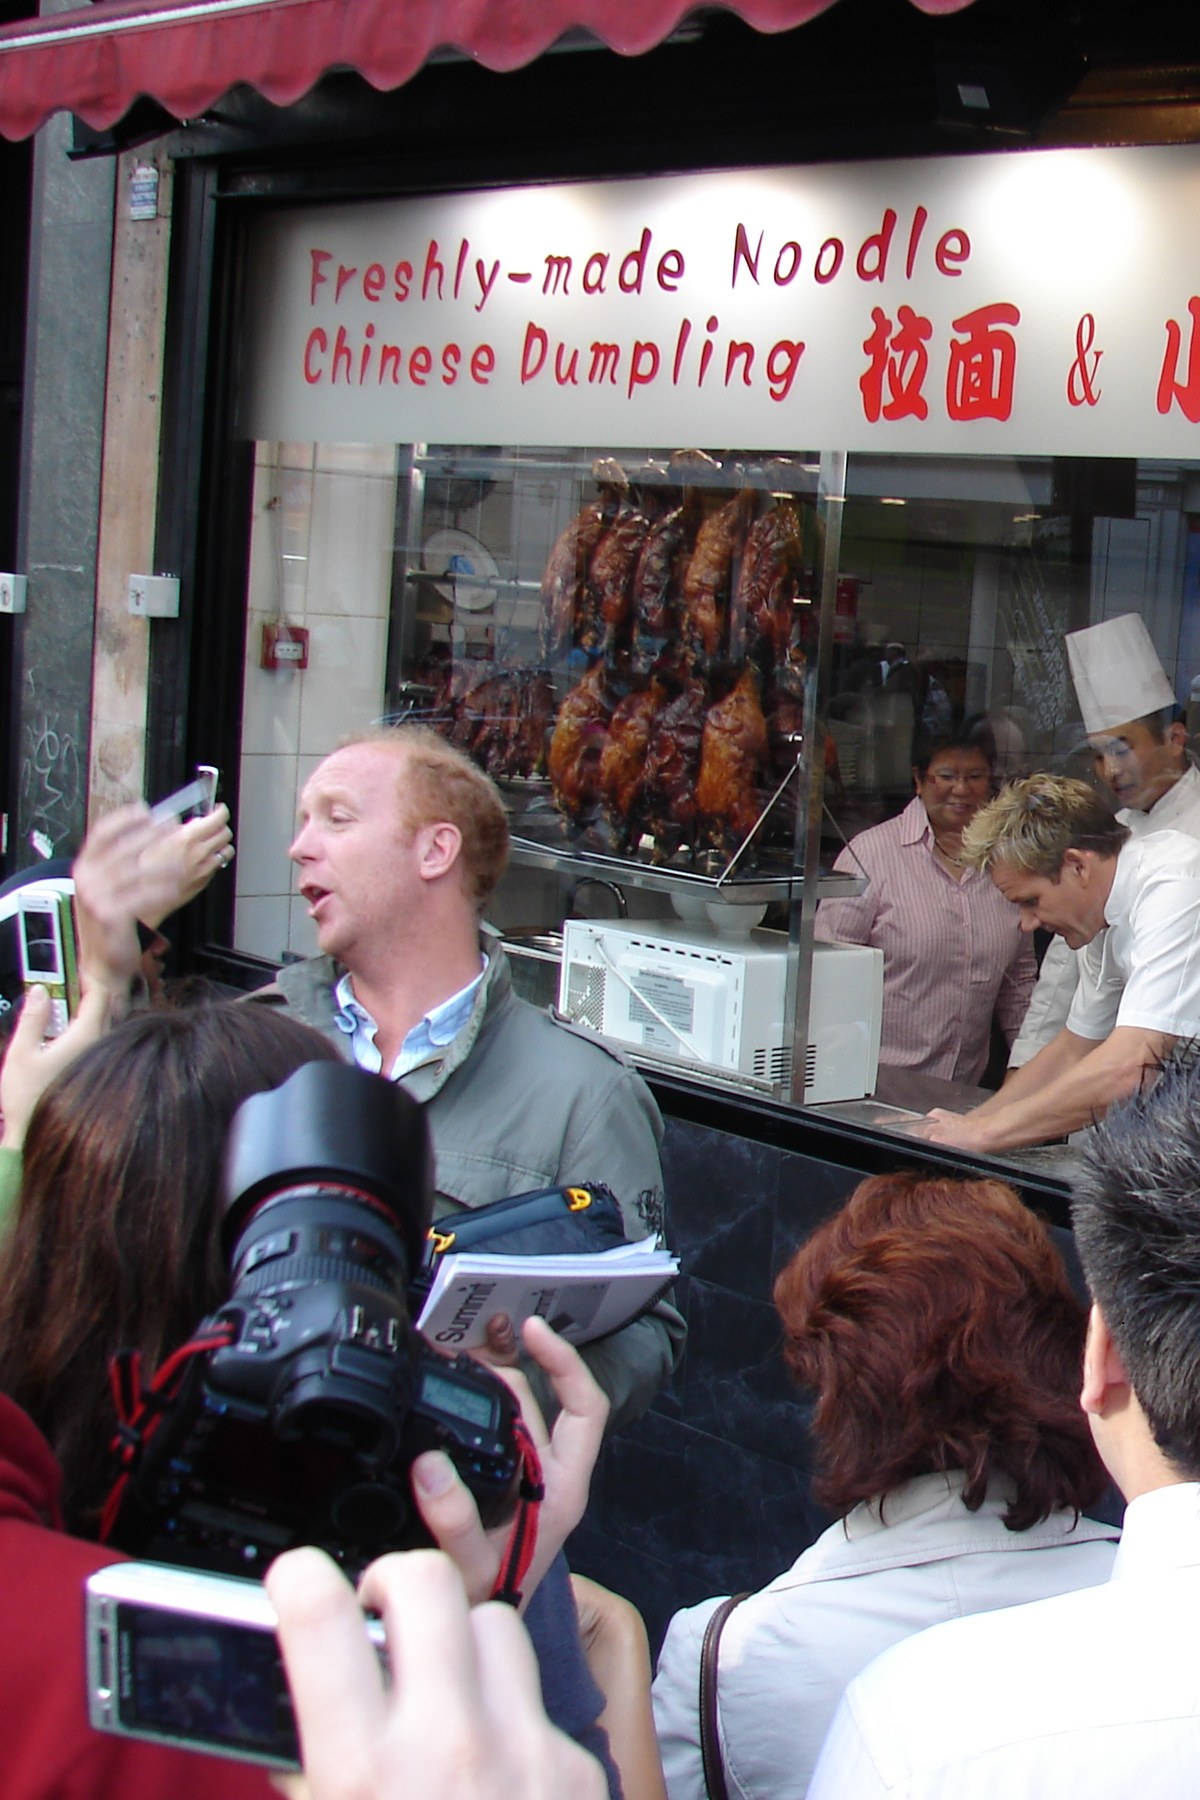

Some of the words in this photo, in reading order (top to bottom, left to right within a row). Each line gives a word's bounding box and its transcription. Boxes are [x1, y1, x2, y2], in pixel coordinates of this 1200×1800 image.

[310, 226, 685, 313] Freshly-made
[731, 205, 971, 289] Noodle
[304, 322, 496, 387] Chinese
[520, 315, 806, 402] Dumpling
[859, 301, 1021, 424] 拉面
[1066, 312, 1104, 407] &
[435, 1280, 498, 1344] Summit
